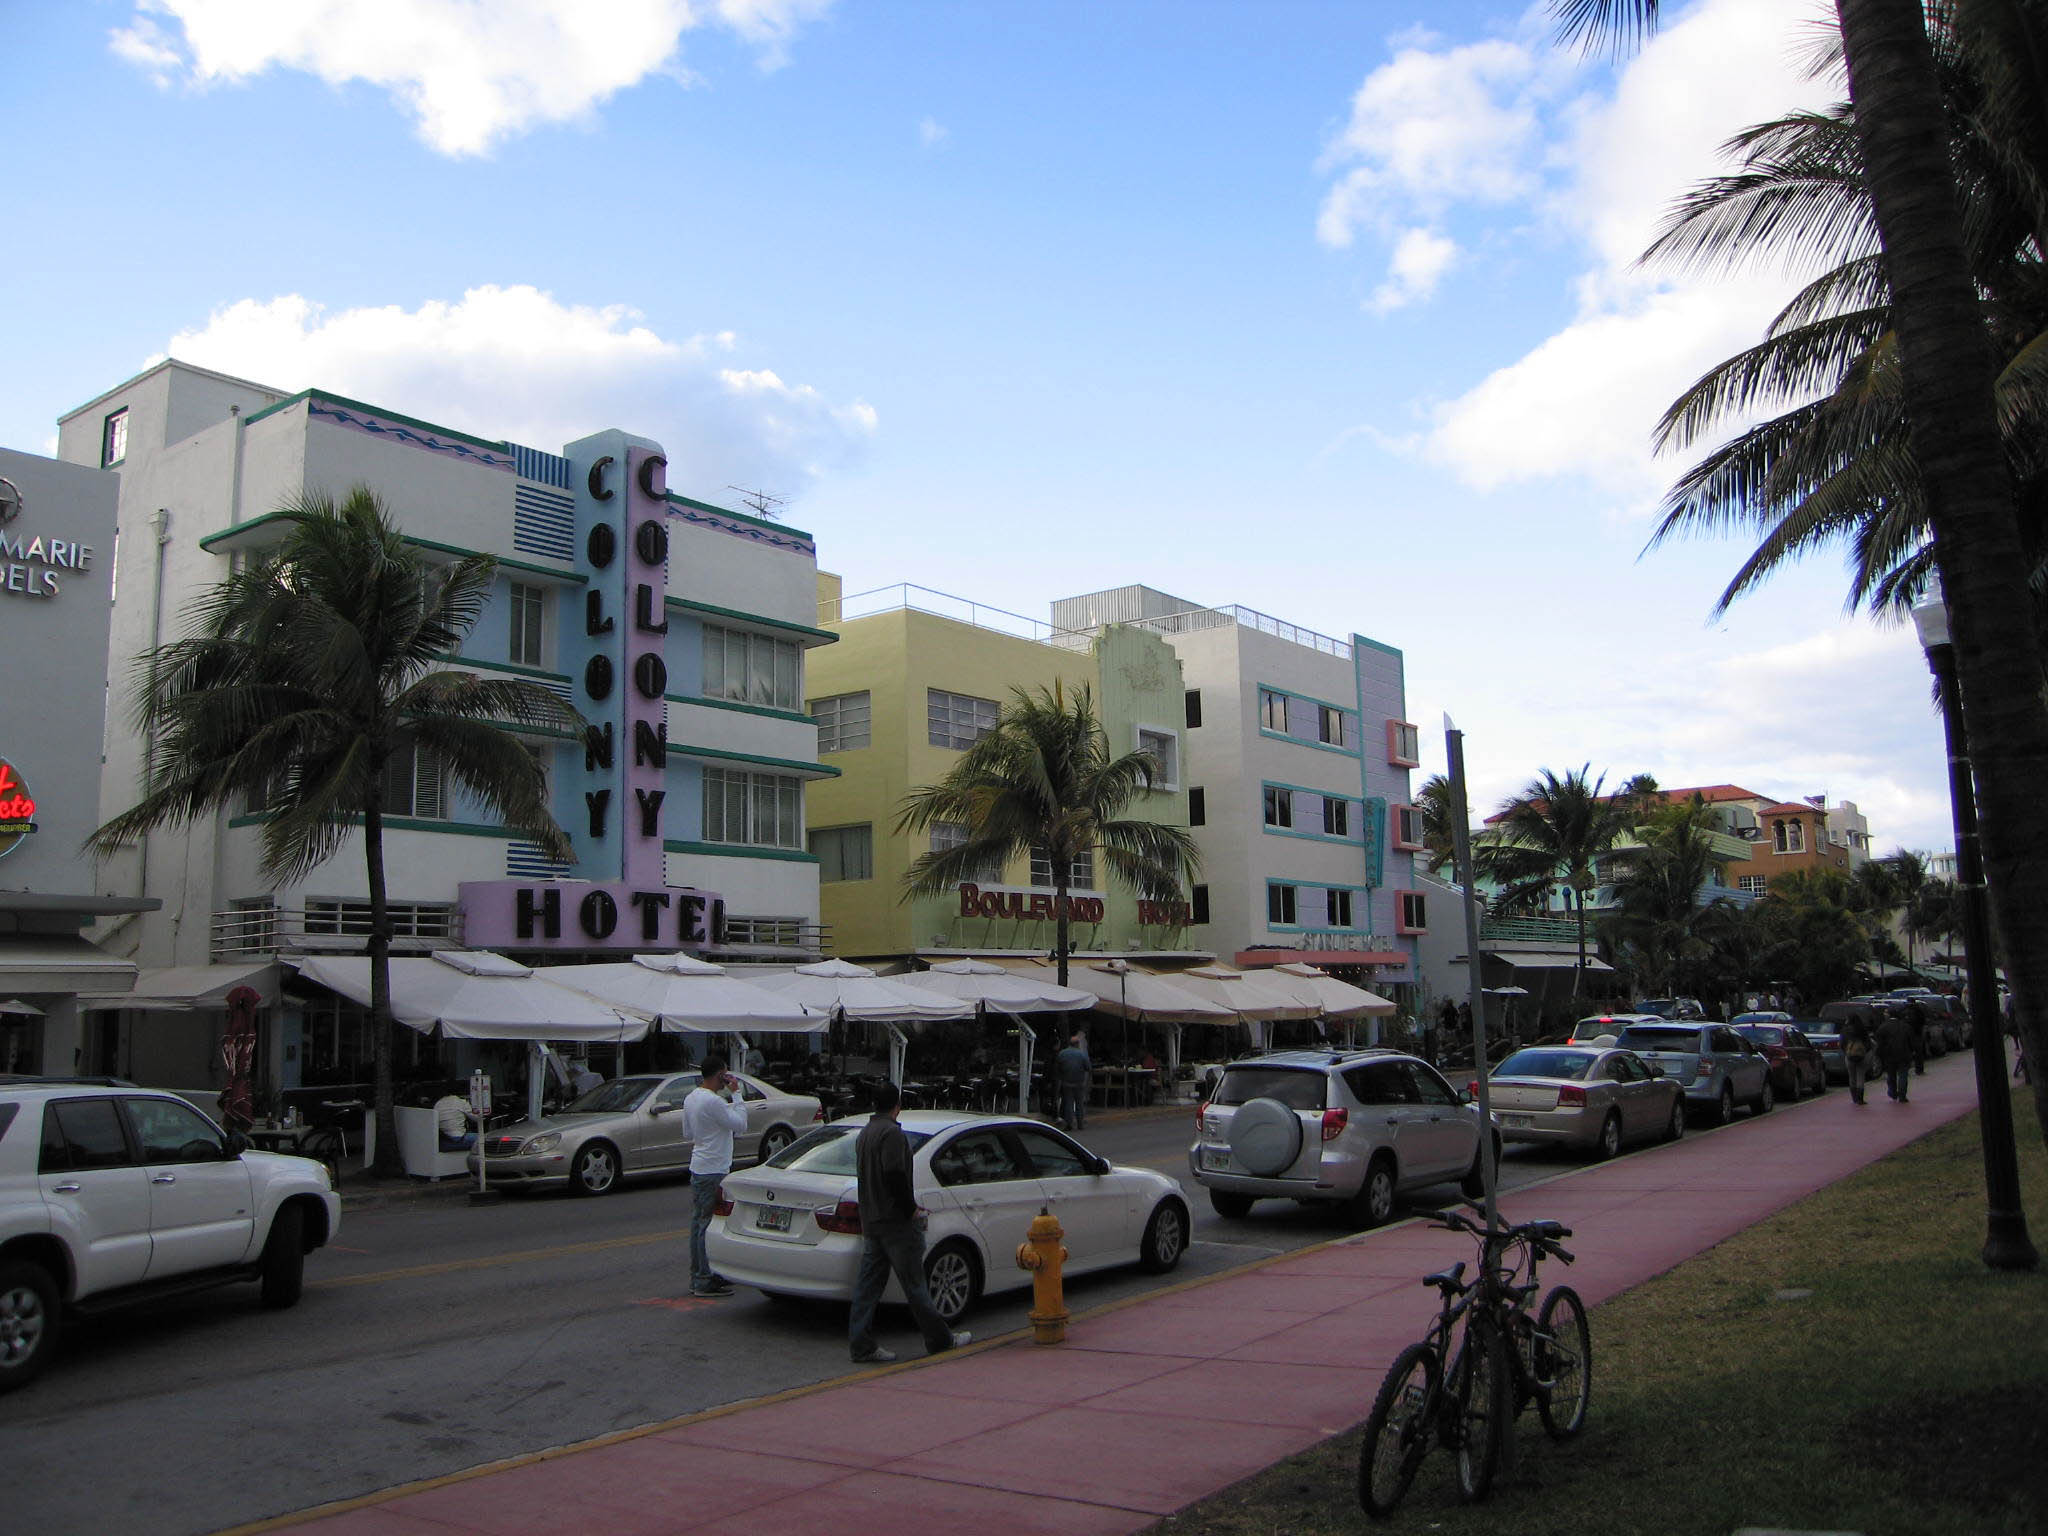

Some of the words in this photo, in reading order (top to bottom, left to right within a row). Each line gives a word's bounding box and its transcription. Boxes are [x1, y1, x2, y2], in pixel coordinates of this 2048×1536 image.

[585, 456, 613, 838] COLONY
[635, 455, 668, 838] COLONY
[517, 888, 728, 945] HOTEL
[960, 883, 1104, 923] BOULEVARD
